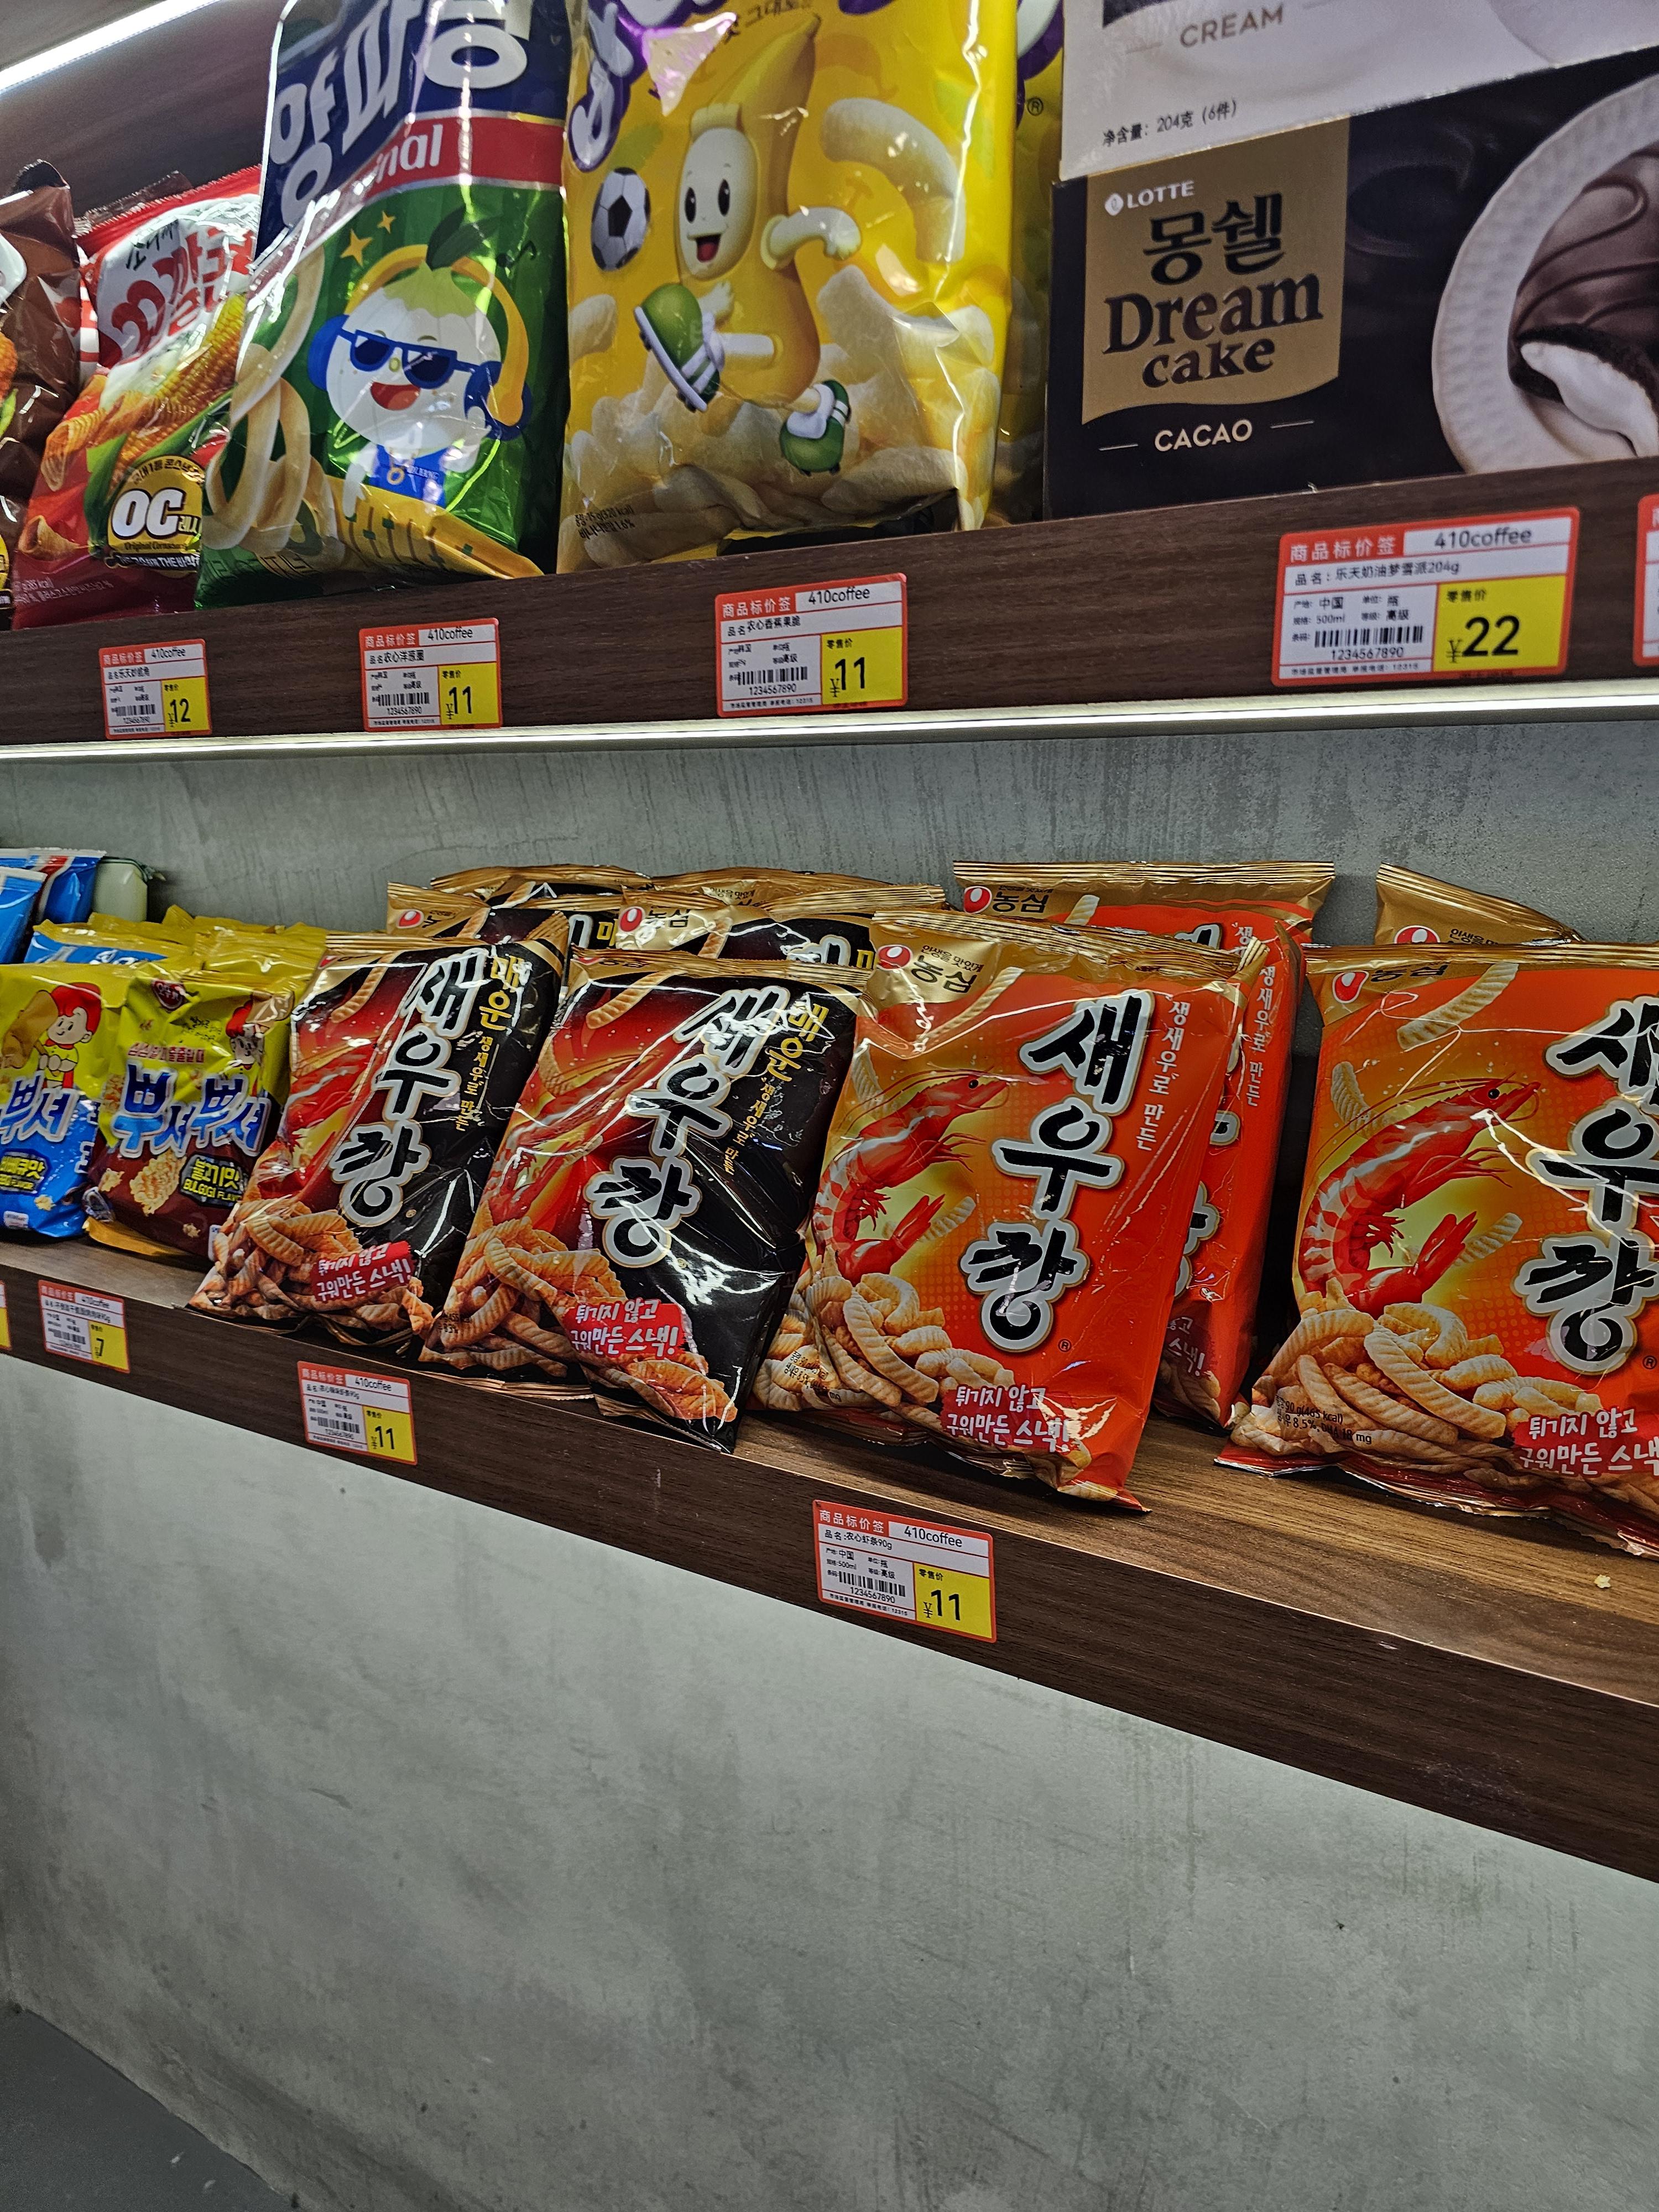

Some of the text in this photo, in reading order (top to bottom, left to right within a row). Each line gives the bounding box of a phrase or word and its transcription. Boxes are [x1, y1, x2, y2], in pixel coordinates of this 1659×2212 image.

[1180, 3, 1284, 48] CREAM
[1103, 98, 1237, 147] 净含量: 204克 (6件)
[1126, 180, 1195, 210] LOTTE
[1143, 191, 1286, 286] 몽쉘
[1102, 272, 1324, 356] Dream
[1141, 336, 1276, 390] cake
[1154, 418, 1254, 453] CACAO
[1290, 536, 1396, 562] 商品标价签
[1434, 526, 1532, 549] 410coffee
[722, 596, 791, 619] 商品标价签
[808, 586, 870, 605] 410coffee
[1319, 596, 1344, 610] 中国
[1447, 589, 1486, 603] 零售价
[427, 626, 474, 641] 410coffee
[1316, 613, 1345, 625] 500ml
[1331, 646, 1405, 661] 1234567890
[749, 683, 797, 696] 1234567890
[992, 891, 1050, 914] 농심
[921, 944, 984, 973] 인생을 맛있게
[910, 954, 978, 994] 농심
[768, 1003, 830, 1082] 매운
[332, 952, 484, 1223] 새우깡
[1245, 1061, 1265, 1107] 만든
[112, 1061, 270, 1157] 뿌셔뿌셔
[1135, 1102, 1166, 1152] 만든
[963, 990, 1151, 1349] 새우깡
[369, 1258, 411, 1288] 스낵!
[575, 1297, 660, 1324] 튀기지 않고
[570, 1324, 680, 1358] 구워만든 스낵!
[955, 1384, 1047, 1413] 튀기지 않고
[946, 1413, 1010, 1446] 구워만든
[1322, 1411, 1344, 1425] kcal)
[1528, 1407, 1638, 1440] 튀기지 않고
[1355, 1433, 1373, 1445] mg
[1519, 1442, 1603, 1475] 구워만든
[819, 1509, 884, 1534] 商品标价签
[904, 1525, 963, 1548] 410coffee
[918, 1568, 944, 1582] 零售价
[850, 1586, 896, 1604] 1234567890
[891, 1608, 907, 1616] 12315
